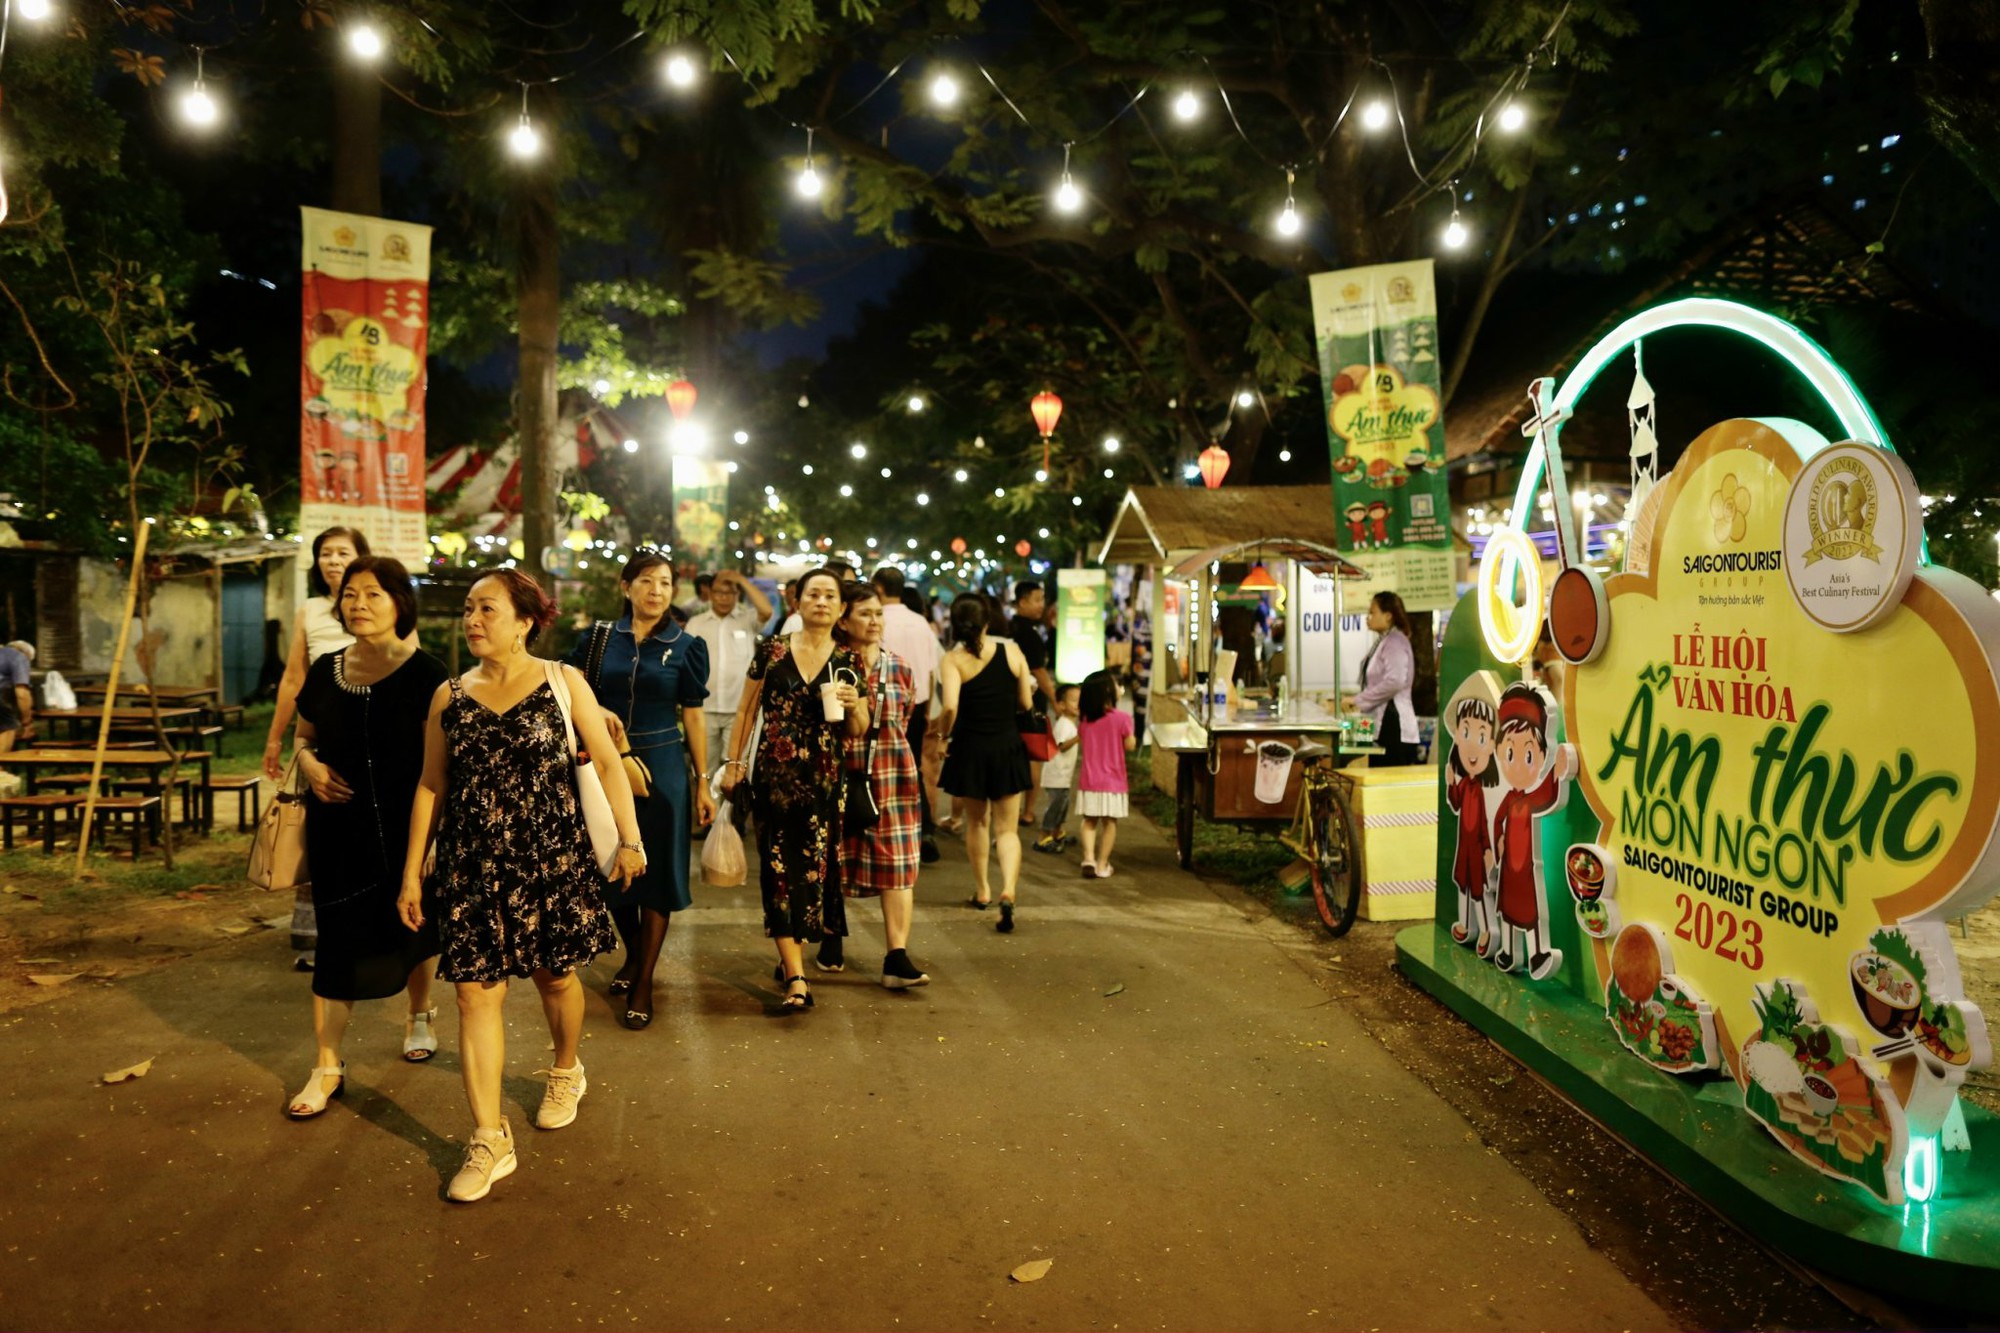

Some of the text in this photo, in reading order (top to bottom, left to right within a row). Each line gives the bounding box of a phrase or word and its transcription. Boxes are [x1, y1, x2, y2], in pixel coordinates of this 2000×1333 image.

[1809, 459, 1876, 534] WORLD CULINARY AWARDS
[1683, 551, 1782, 574] SAIGONTOURIST
[1817, 530, 1866, 547] WINNER
[1699, 575, 1764, 588] GROUP
[1802, 584, 1881, 601] Best Culinary Festival
[1829, 573, 1851, 585] Asia's
[1303, 611, 1361, 632] COUON
[1673, 622, 1767, 680] LỄ HỘI
[1672, 670, 1798, 723] VĂN HÓA
[1597, 663, 1959, 864] Ẩm thực
[1714, 809, 1847, 906] NGON
[1623, 844, 1839, 939] SAIGONTOURIST GROUP
[1674, 893, 1765, 972] 2023
